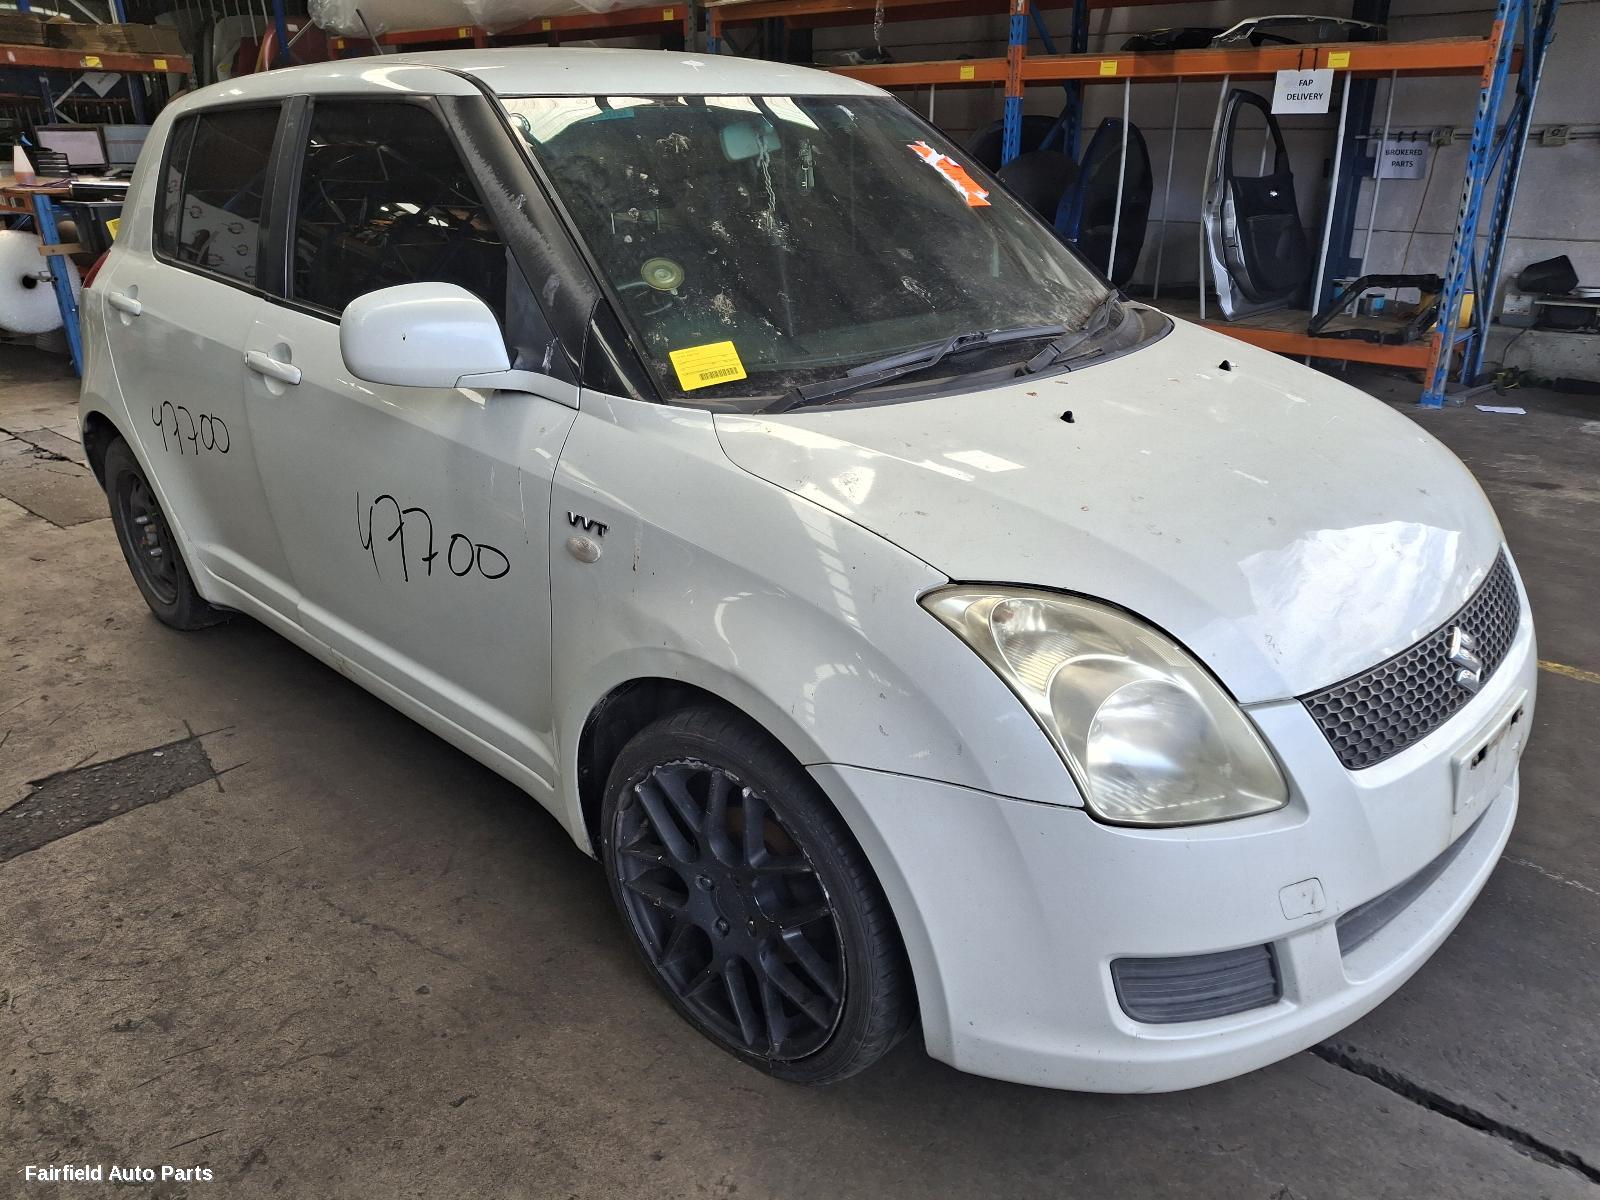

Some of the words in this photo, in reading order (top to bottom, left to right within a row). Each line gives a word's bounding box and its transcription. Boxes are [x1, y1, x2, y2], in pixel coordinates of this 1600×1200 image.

[1298, 79, 1314, 87] FAP
[1286, 92, 1324, 101] DELIVERY
[1391, 160, 1414, 168] PARTS
[567, 510, 609, 537] VVT
